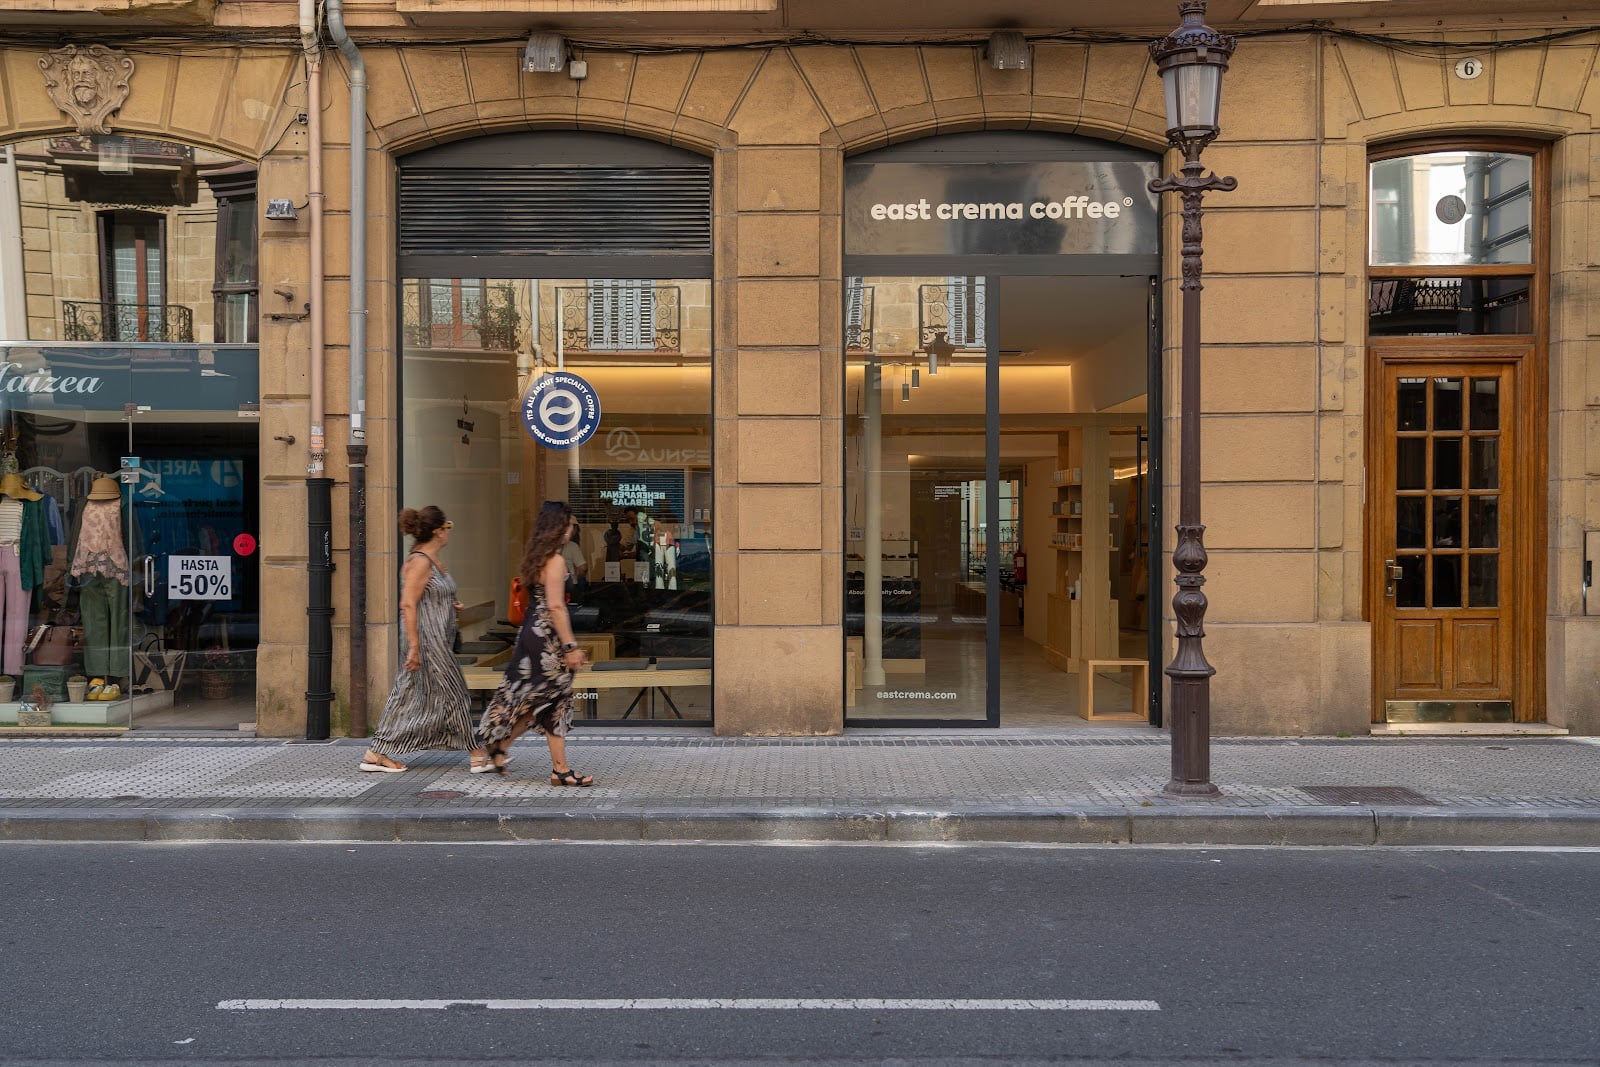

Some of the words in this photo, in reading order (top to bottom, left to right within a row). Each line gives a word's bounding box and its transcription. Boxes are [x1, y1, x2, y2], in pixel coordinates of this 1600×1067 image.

[1463, 61, 1476, 77] 6
[870, 198, 931, 220] east
[936, 199, 1024, 220] crema
[527, 396, 536, 408] ALL
[533, 377, 554, 396] ABOUT
[555, 376, 589, 394] SPECIALTY
[585, 394, 595, 420] COFFEE
[531, 424, 546, 440] east
[544, 436, 570, 445] crema
[570, 424, 591, 443] coffee
[181, 559, 219, 571] HASTA
[170, 575, 229, 596] -50%
[876, 690, 957, 700] eastcrema.com
